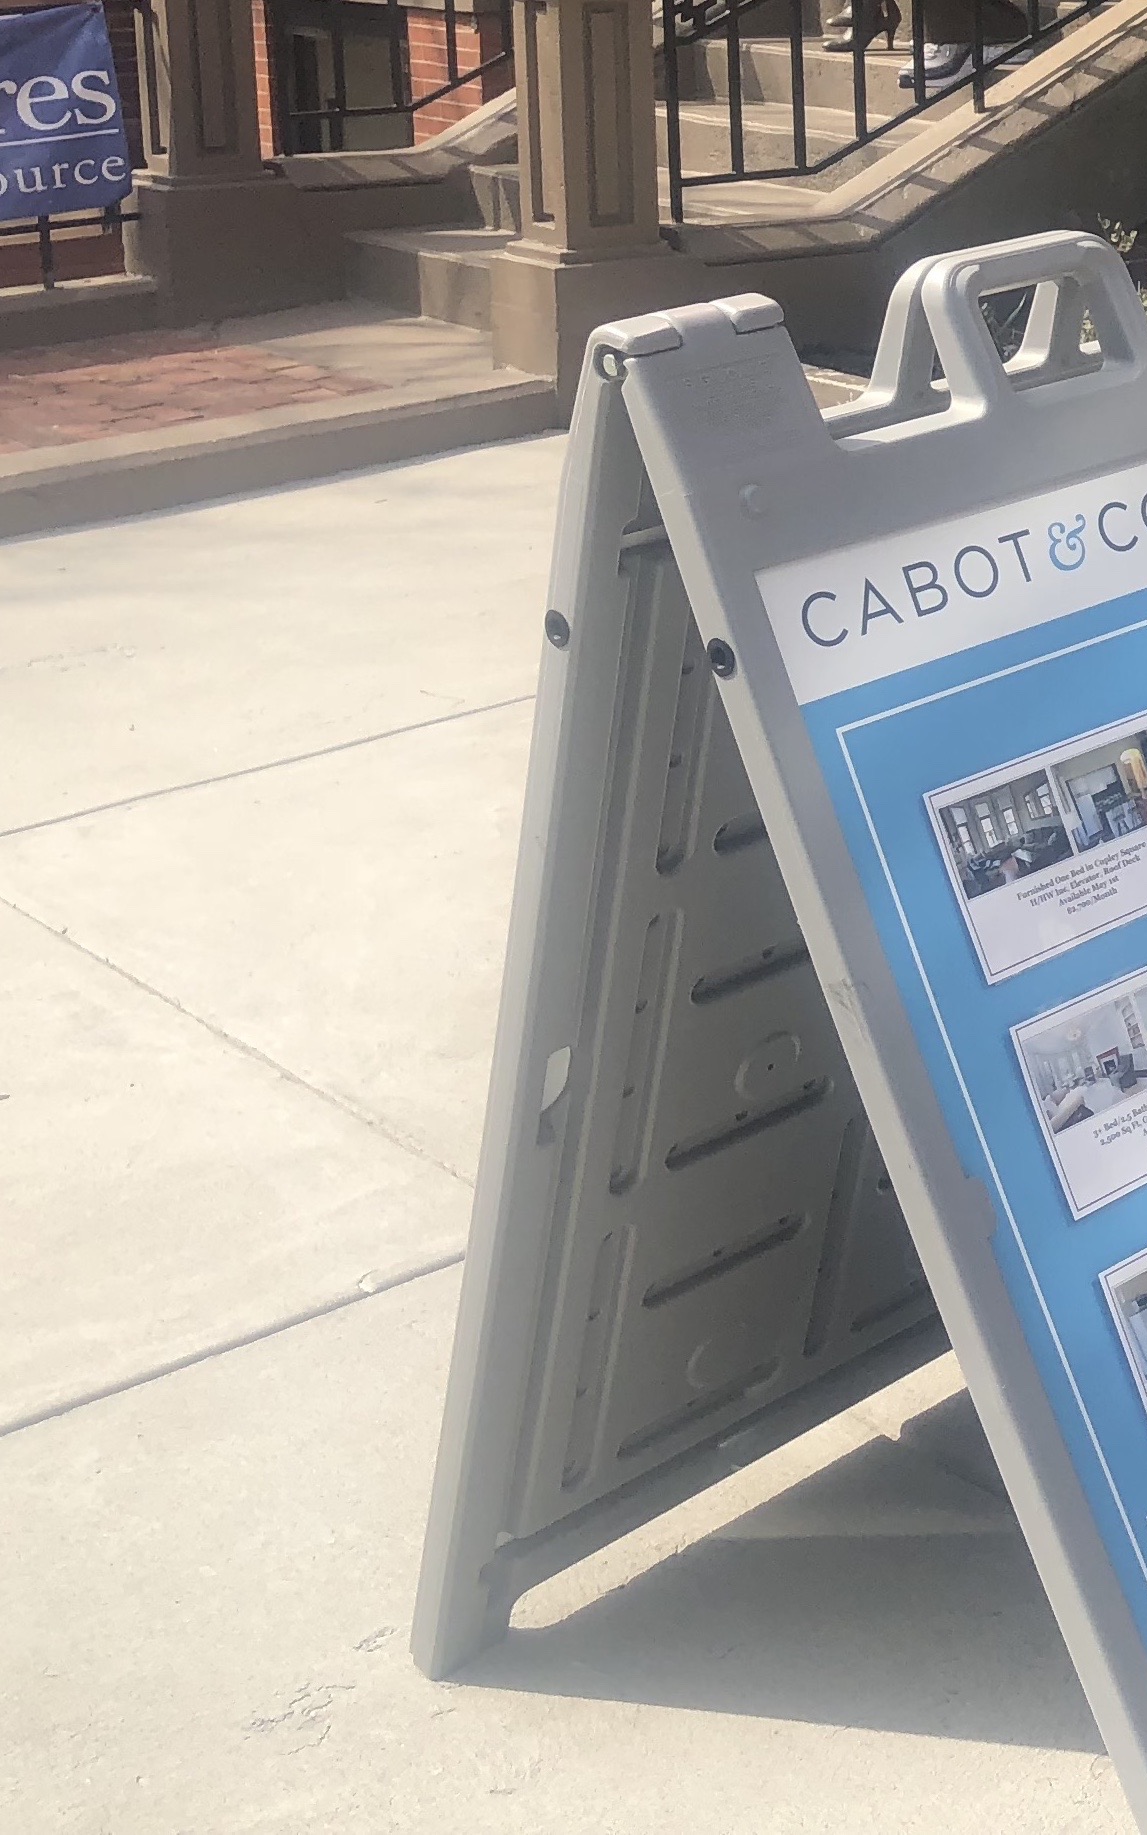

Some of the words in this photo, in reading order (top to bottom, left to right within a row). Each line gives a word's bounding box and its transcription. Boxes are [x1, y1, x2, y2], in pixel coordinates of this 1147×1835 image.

[0, 155, 126, 195] urce
[801, 529, 1031, 647] CABOT
[1017, 879, 1054, 900] Furnished
[1055, 874, 1069, 885] One
[1070, 866, 1085, 879] Bed
[1094, 853, 1119, 867] Copley
[1120, 842, 1146, 857] Square
[1103, 861, 1121, 875] Roof
[1122, 854, 1141, 868] Deck
[1059, 888, 1091, 906] Available
[1092, 881, 1107, 893] May
[1093, 1129, 1103, 1139] 3+
[1104, 1113, 1132, 1131] Bed/2.5
[1121, 1126, 1133, 1136] Sq
